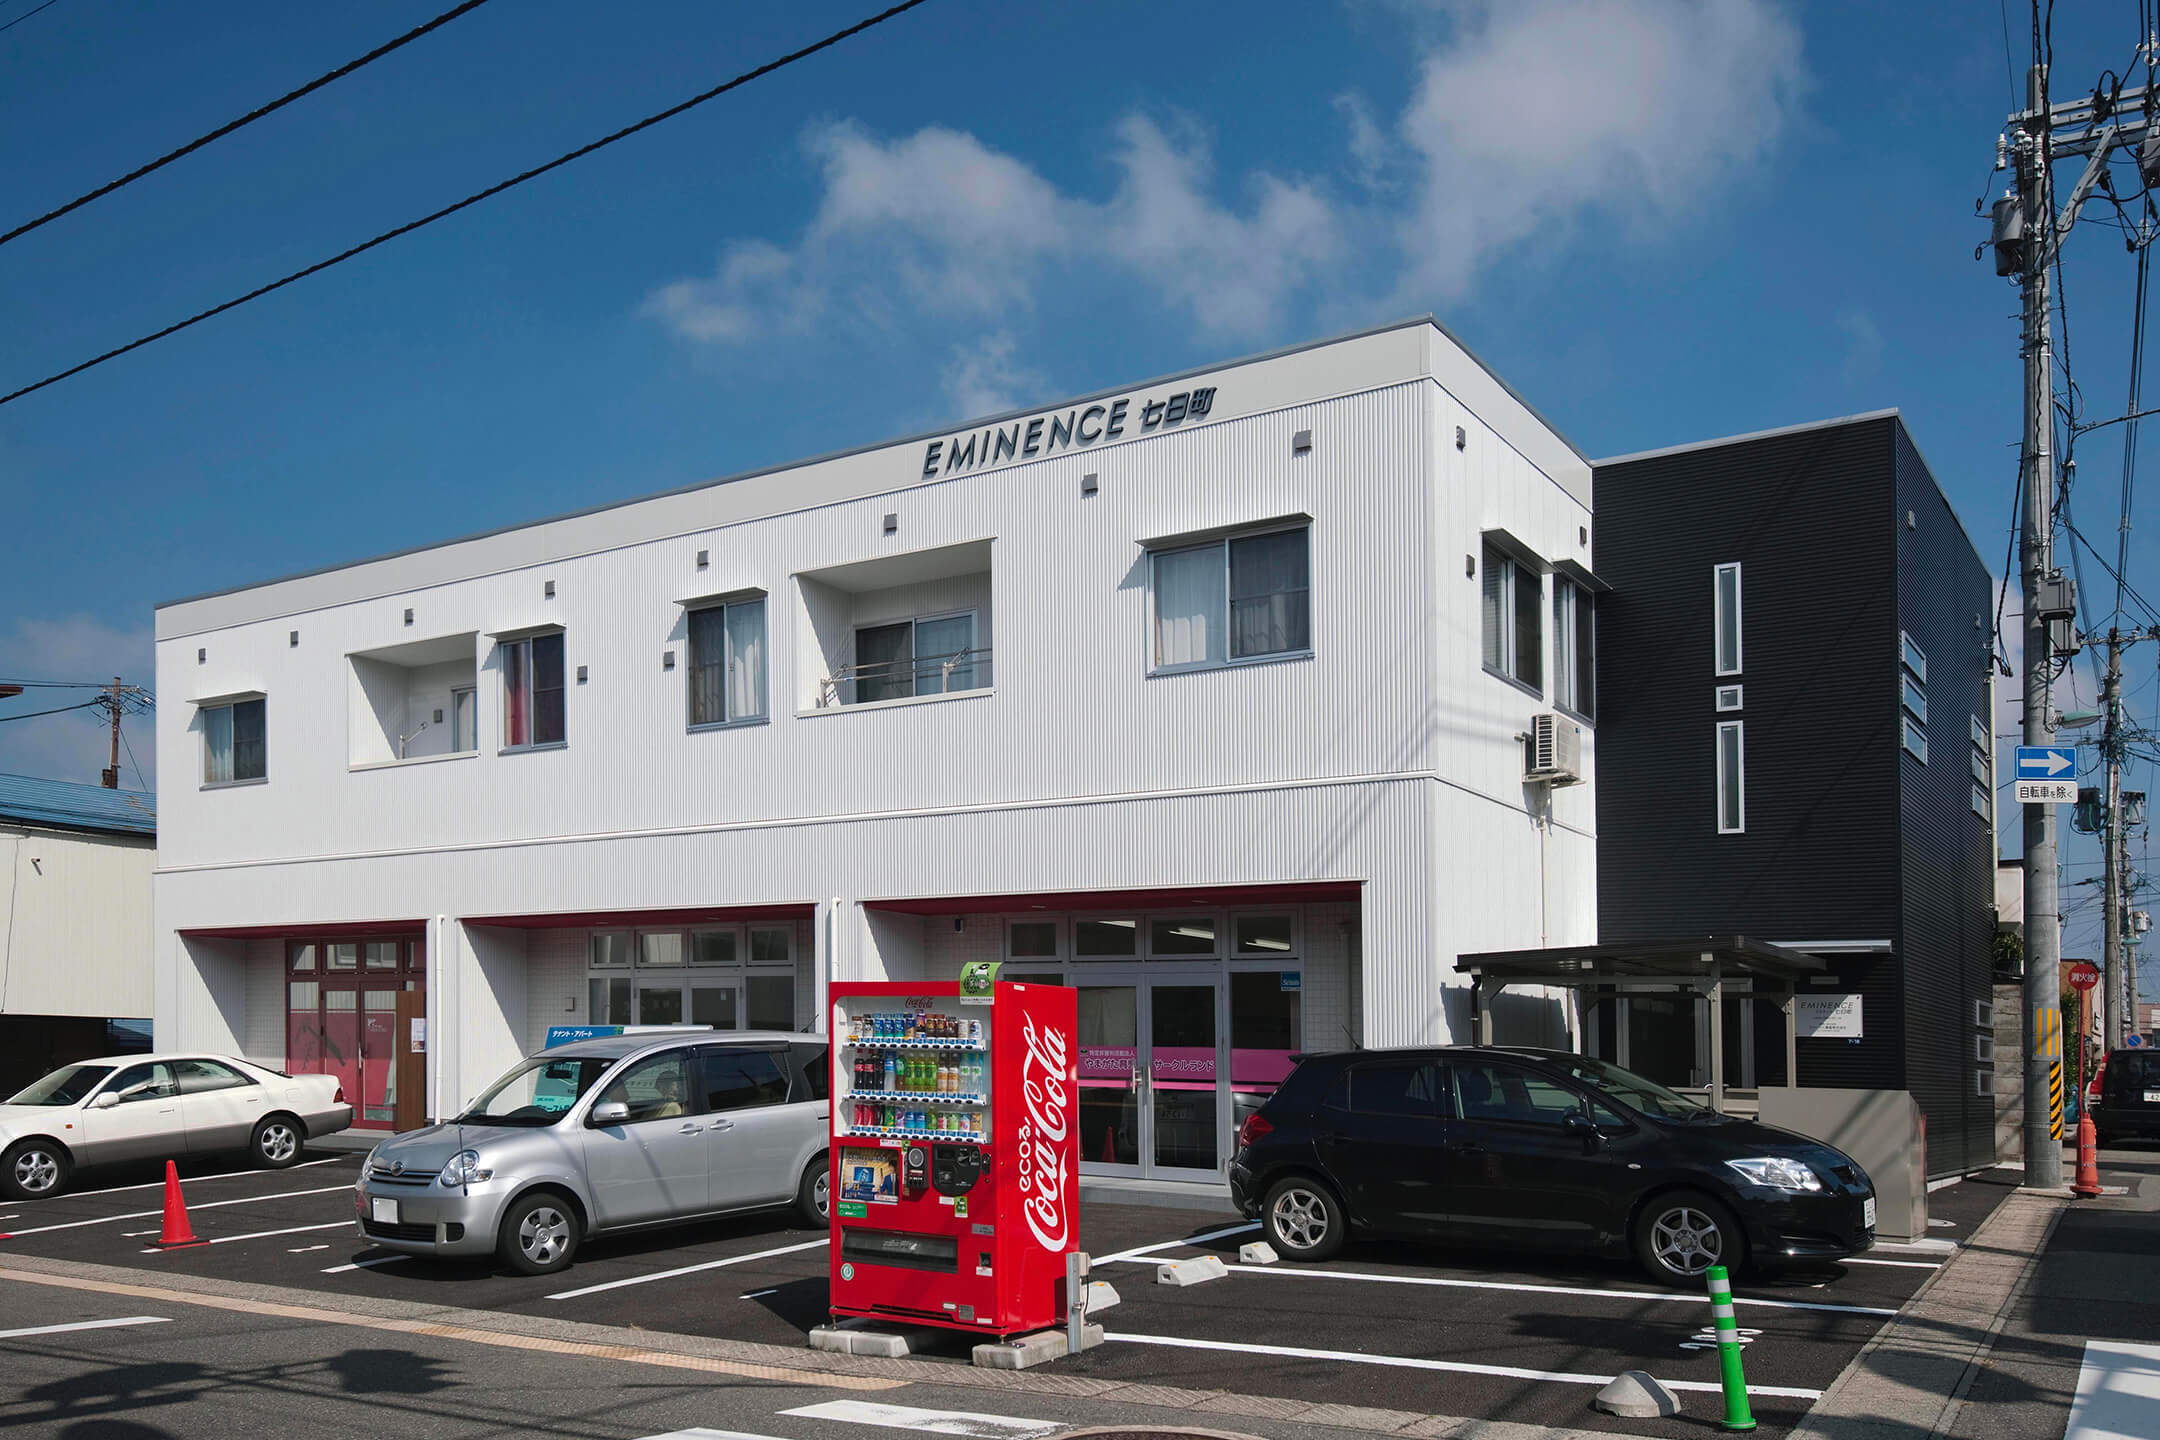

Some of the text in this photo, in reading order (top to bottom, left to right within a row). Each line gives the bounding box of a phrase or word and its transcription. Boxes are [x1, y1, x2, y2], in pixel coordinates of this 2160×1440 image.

[923, 387, 1217, 475] EMINENCE 七日町
[2020, 786, 2073, 799] 自転車を除く
[1800, 1001, 1854, 1009] EMINENCE
[1153, 1059, 1215, 1072] サークルランド
[1023, 1009, 1068, 1252] Coca-Cola
